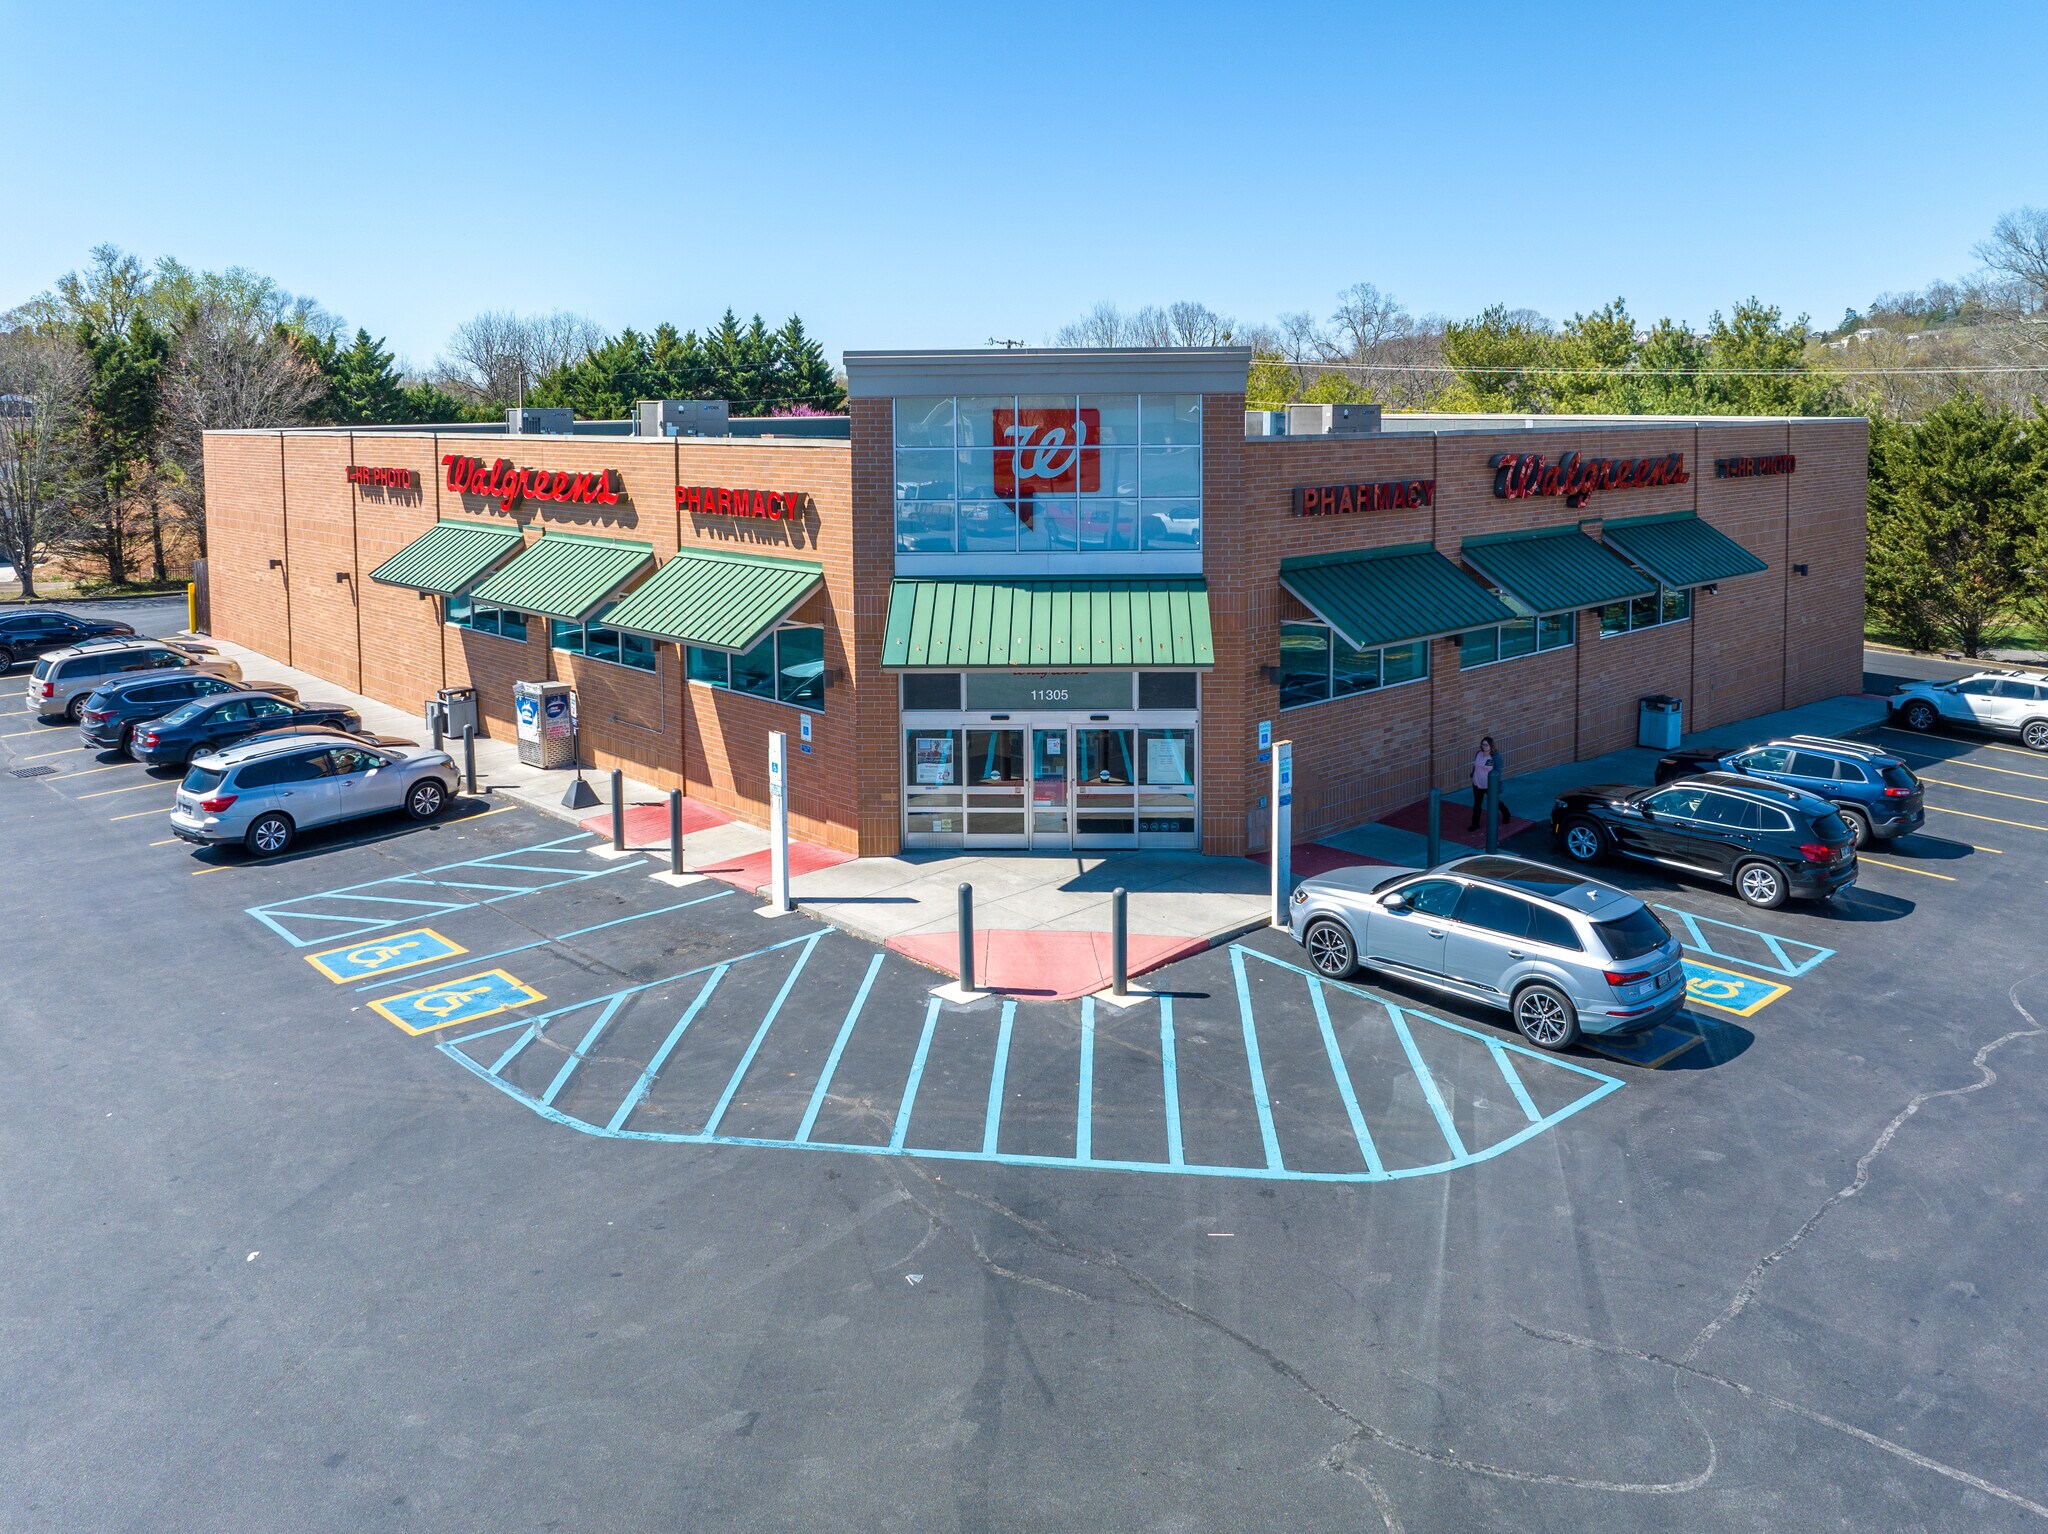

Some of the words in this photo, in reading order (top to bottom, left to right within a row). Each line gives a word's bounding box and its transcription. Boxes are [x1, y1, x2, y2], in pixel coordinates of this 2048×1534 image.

[1004, 420, 1087, 479] W
[1724, 457, 1754, 478] 1-HR
[1758, 454, 1796, 476] PHOTO
[345, 466, 371, 486] 1-HR
[373, 467, 411, 489] PHOTO
[441, 454, 620, 512] Walgreens
[1498, 451, 1690, 508] Walgreens
[675, 485, 798, 520] PHARMACY
[1303, 480, 1437, 517] PHARMACY
[1030, 689, 1069, 701] 11305
